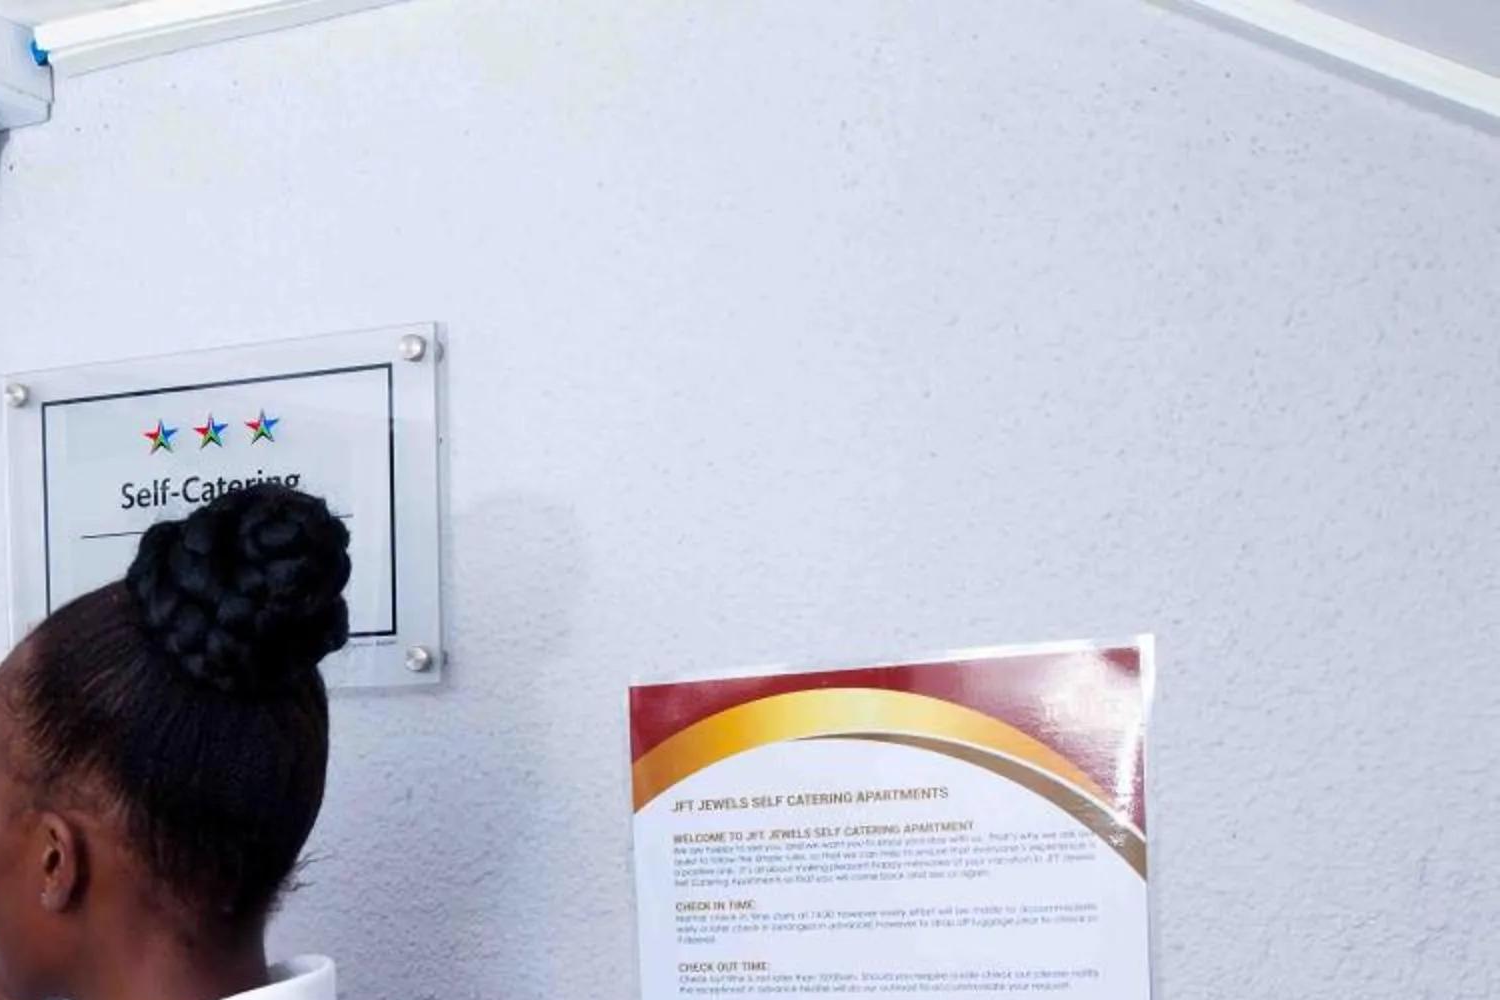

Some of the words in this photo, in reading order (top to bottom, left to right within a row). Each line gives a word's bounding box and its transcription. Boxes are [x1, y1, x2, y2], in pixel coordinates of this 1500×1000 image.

[672, 799, 694, 812] JFT
[698, 797, 748, 811] JEWELS
[751, 795, 784, 809] SELF
[787, 792, 852, 807] CATERING
[855, 787, 949, 803] APARTMENTS
[673, 832, 726, 845] WELCOME
[729, 832, 742, 842] TO
[768, 829, 811, 841] JEWELS
[813, 827, 841, 839] SELF
[844, 824, 900, 837] CATERING
[904, 821, 974, 833] APARTMENT
[676, 901, 710, 912] CHECK
[713, 901, 725, 911] IN
[678, 962, 714, 973] CHECK
[717, 961, 738, 972] OUT
